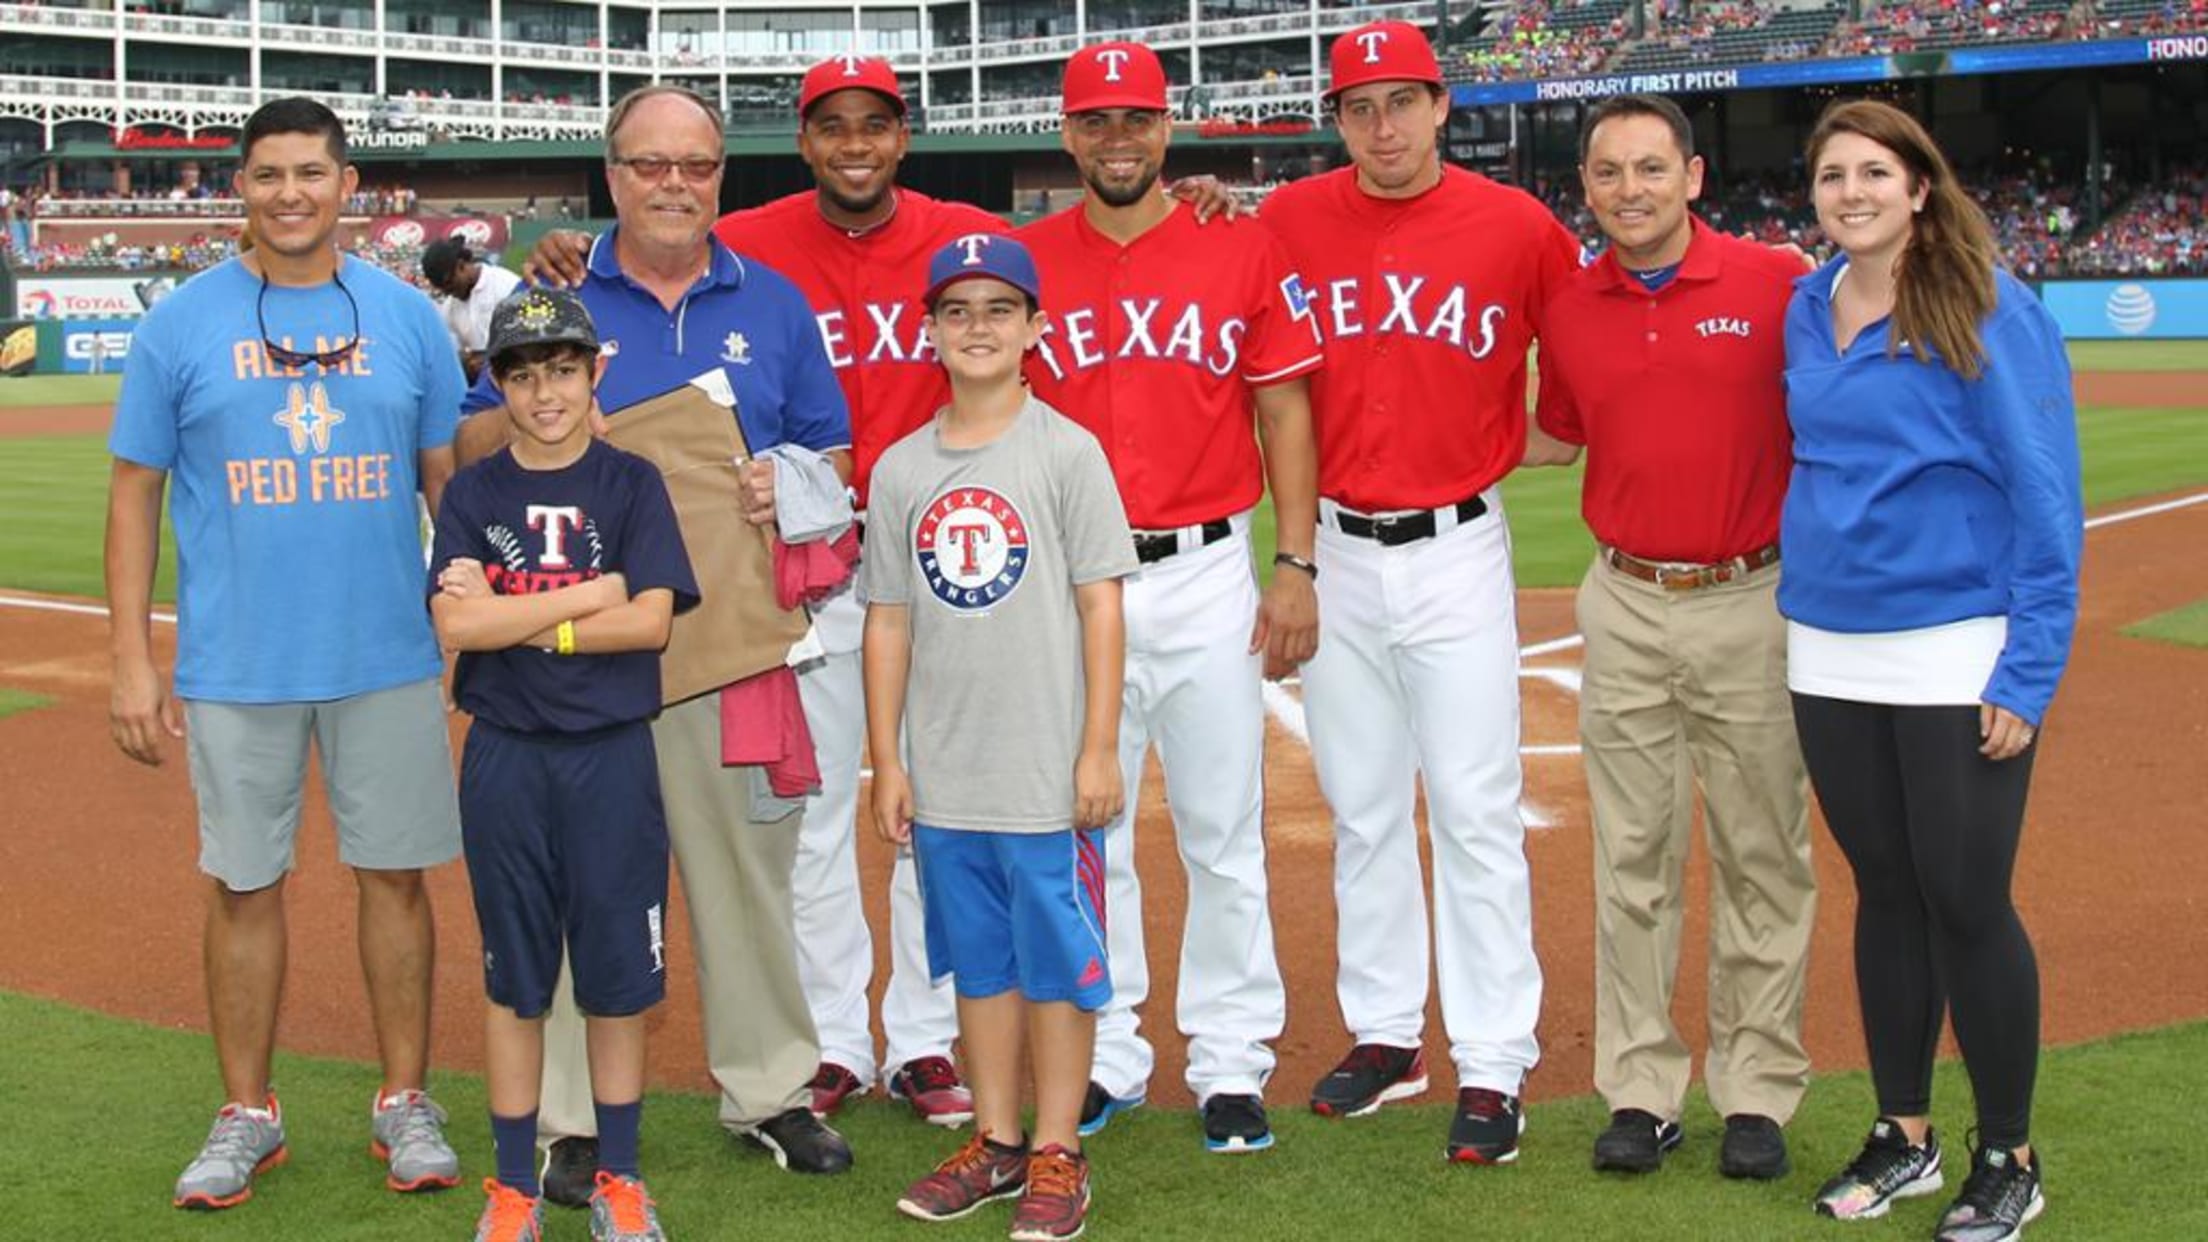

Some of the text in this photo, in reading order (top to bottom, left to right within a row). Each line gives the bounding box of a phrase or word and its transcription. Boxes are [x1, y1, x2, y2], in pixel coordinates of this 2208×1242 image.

[1357, 31, 1388, 63] T
[2146, 37, 2207, 60] HONO
[834, 52, 866, 76] T
[1096, 49, 1129, 81] T
[1536, 69, 1738, 99] HONORARY FIRST PITCH
[956, 234, 990, 266] T
[64, 295, 131, 311] TOTAL
[1303, 274, 1506, 359] TEXAS
[1037, 299, 1246, 381] TEXAS
[1694, 316, 1751, 337] TEXAS
[233, 333, 377, 380] ALL ME
[226, 453, 392, 505] PED FREE
[928, 490, 1012, 523] TEXAS
[526, 504, 585, 570] T
[948, 524, 991, 577] T
[926, 555, 1023, 604] RANGERS
